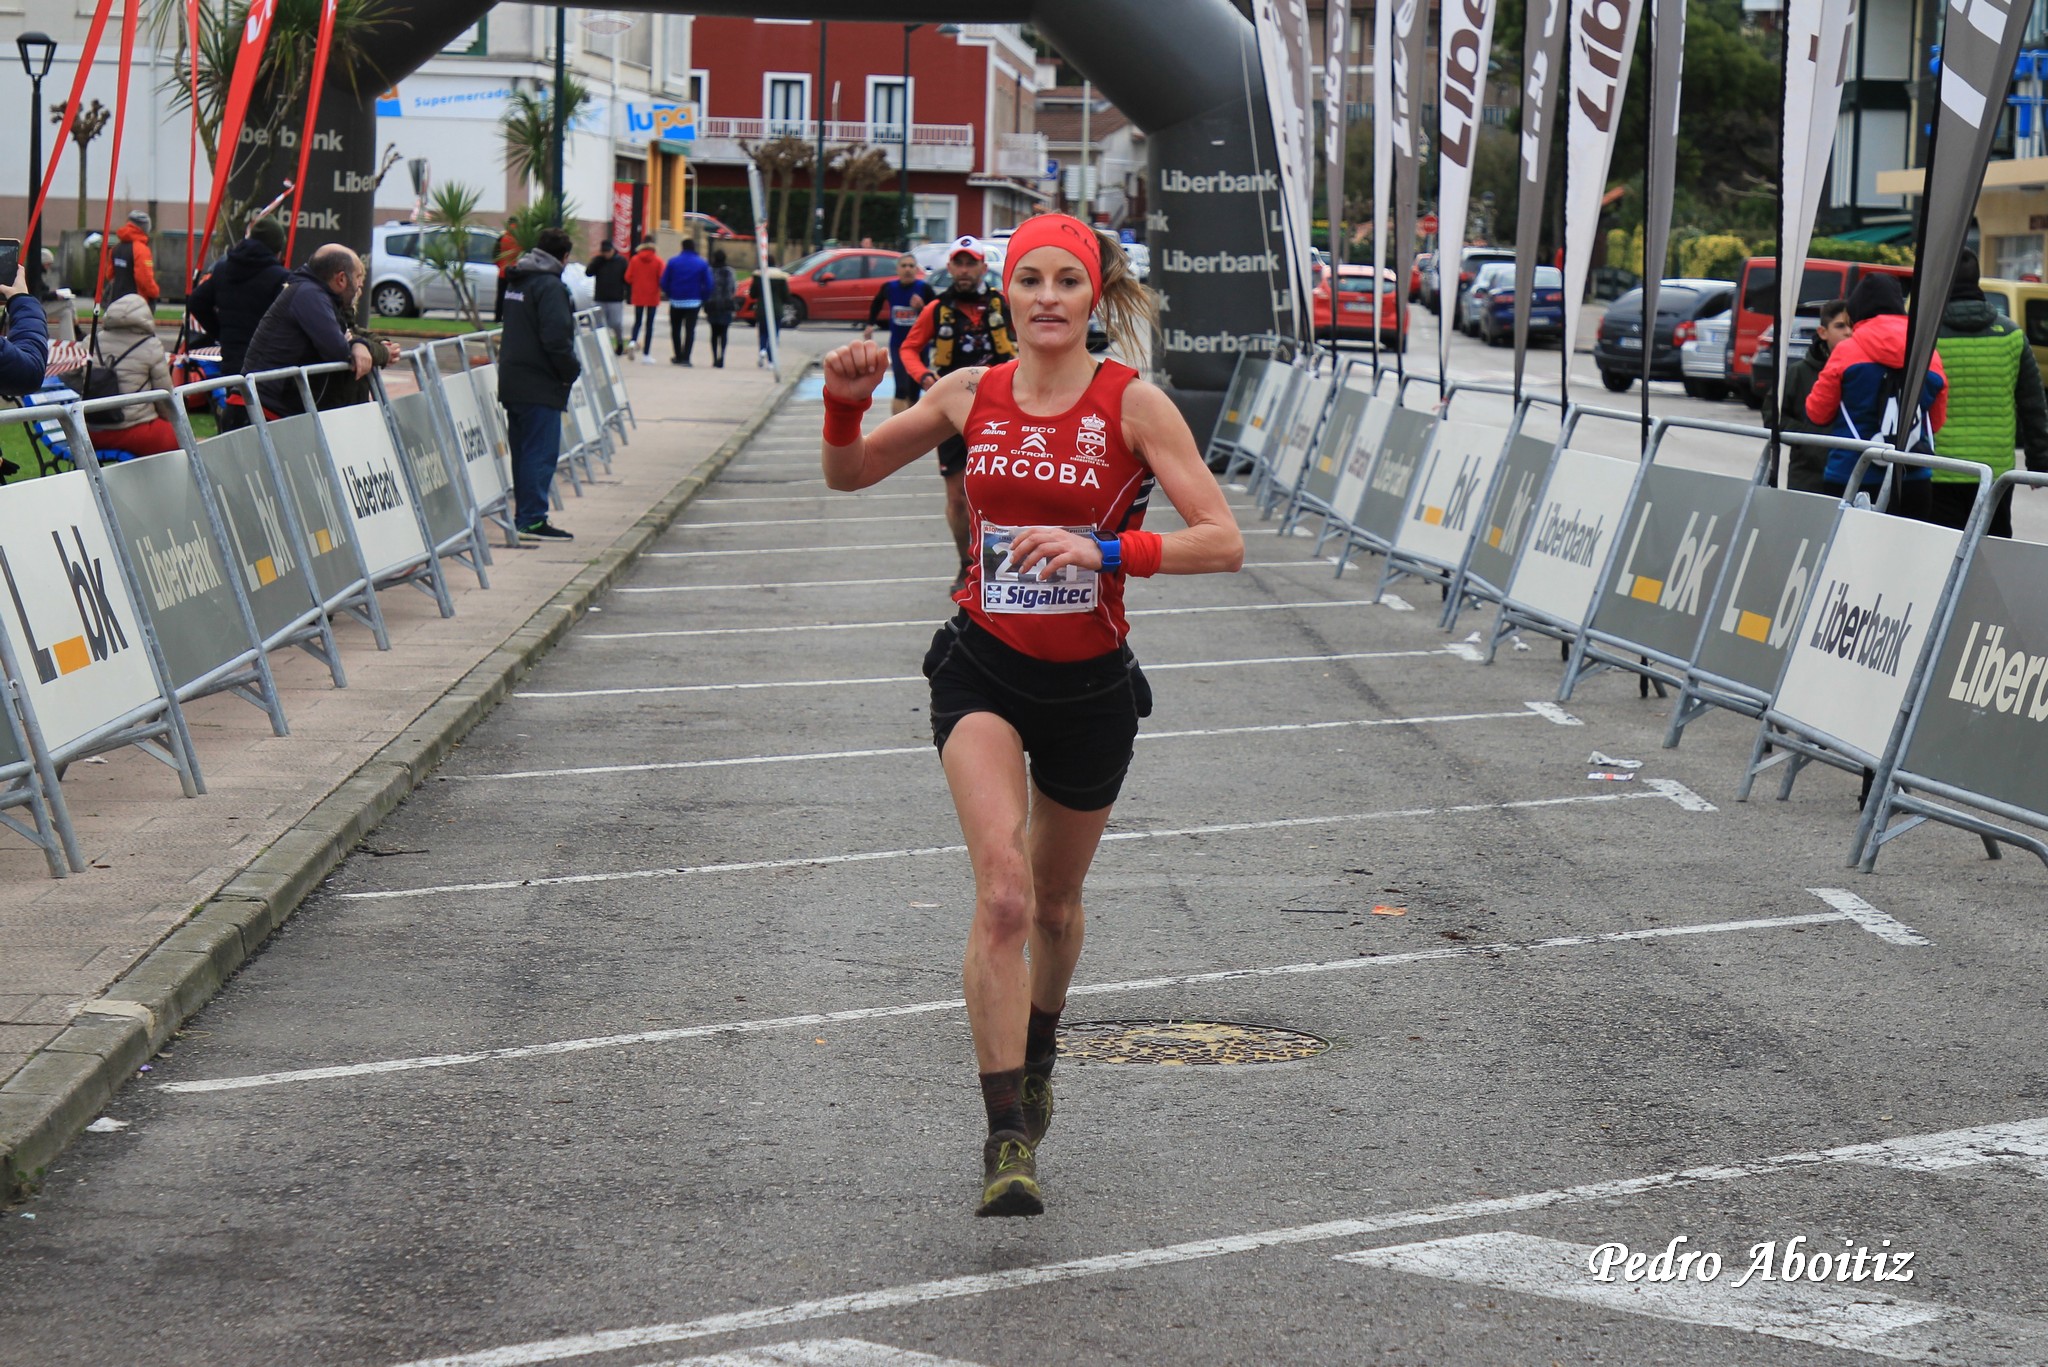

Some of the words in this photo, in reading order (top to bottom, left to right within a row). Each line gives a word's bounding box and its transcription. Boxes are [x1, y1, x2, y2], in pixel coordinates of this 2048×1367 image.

[414, 88, 511, 108] Supermercado
[626, 102, 694, 137] lupa
[1160, 169, 1279, 193] Liberbank
[1162, 249, 1280, 273] Liberbank
[1021, 425, 1056, 434] BECO
[342, 457, 404, 520] Liberbank
[965, 455, 1101, 489] CARCOBA
[1534, 501, 1604, 568] Liberbank
[136, 520, 222, 611] Liberbank
[1005, 585, 1092, 609] Sigaltec
[1809, 579, 1913, 677] Liberbank
